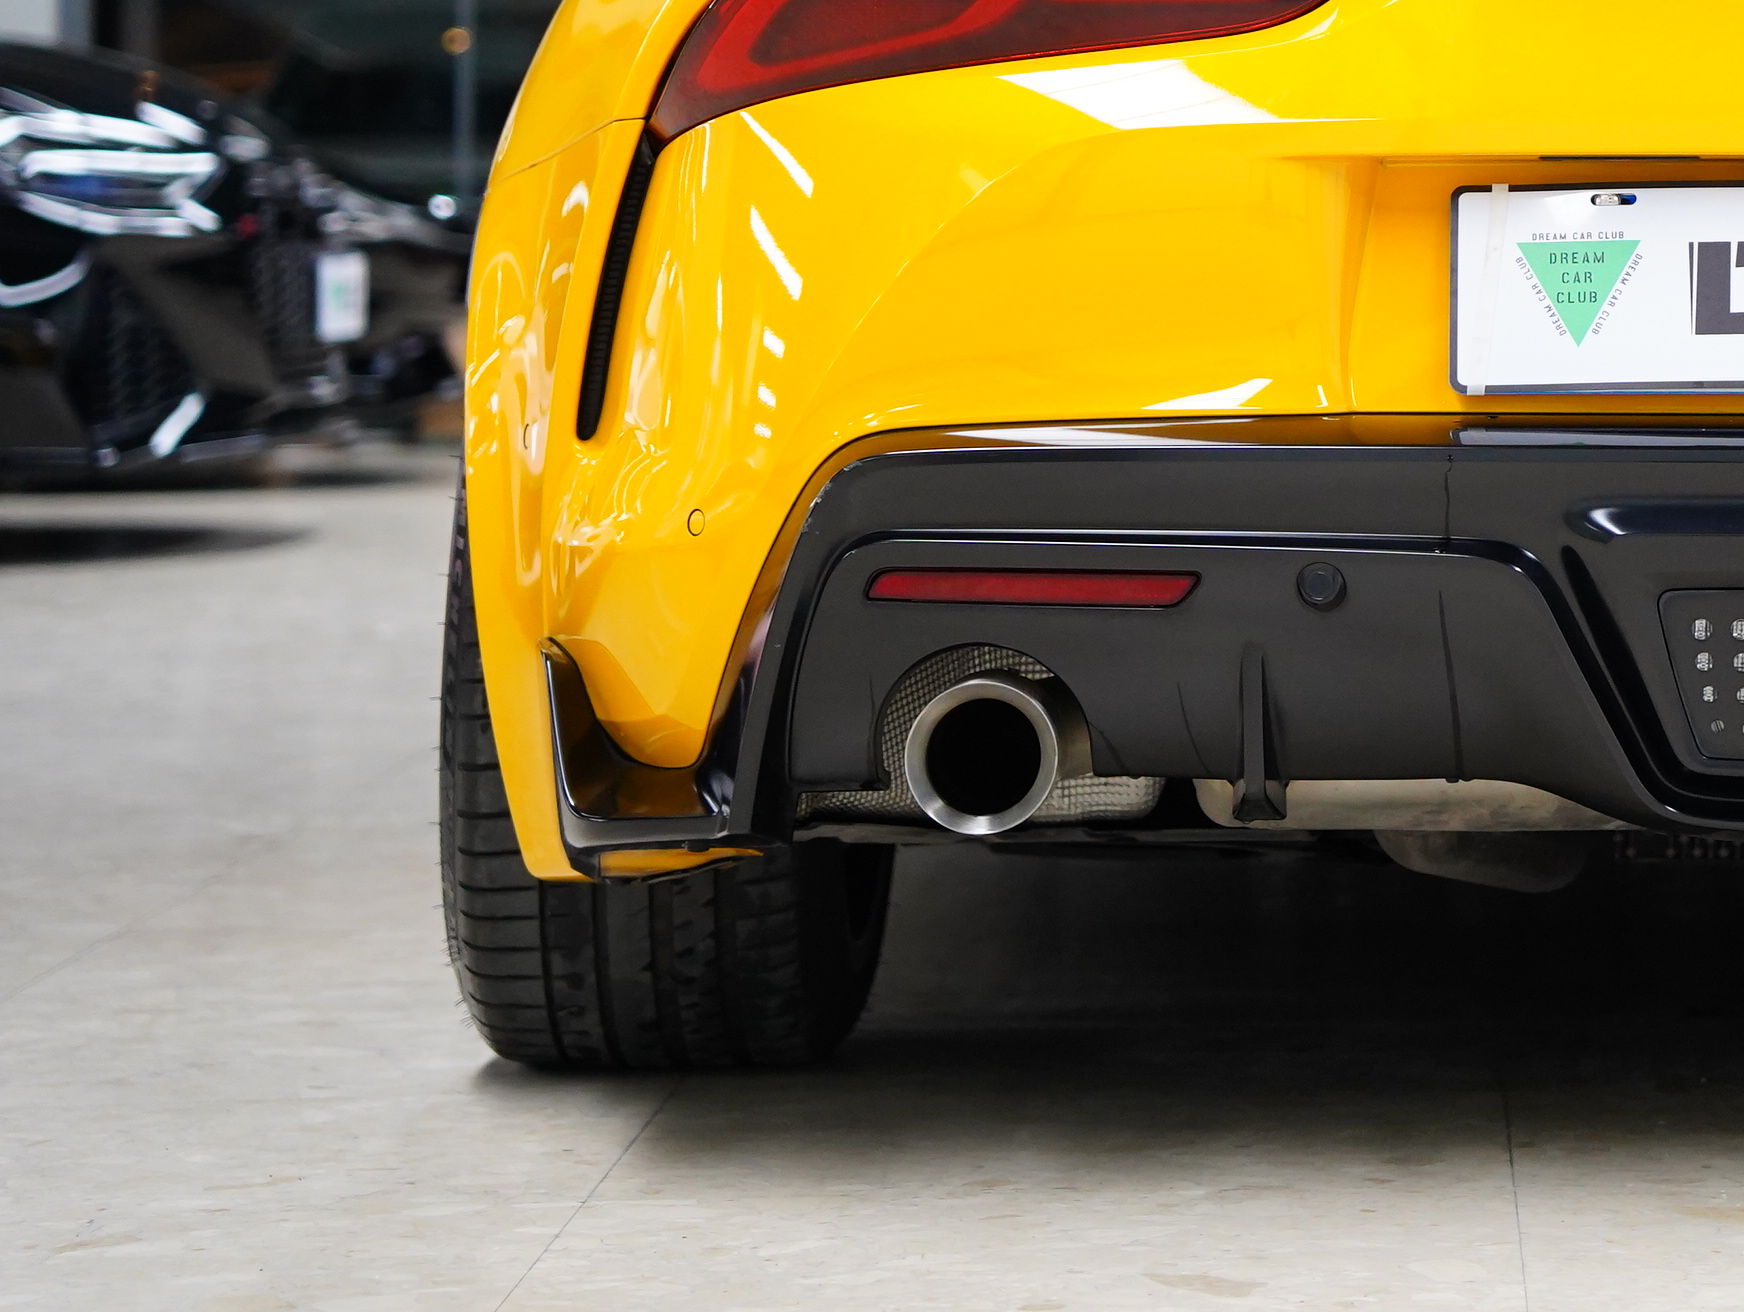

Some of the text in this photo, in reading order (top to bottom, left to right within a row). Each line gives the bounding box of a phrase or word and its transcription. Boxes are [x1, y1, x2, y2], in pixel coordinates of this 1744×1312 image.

[1532, 231, 1625, 241] DREAM CAR CLUB
[1549, 251, 1605, 264] DREAM
[1562, 271, 1593, 284] CAR
[1515, 256, 1567, 336] DREAM CAR CLUB
[1556, 291, 1598, 304] CLUB
[1591, 253, 1643, 335] DREAM CAR CLUB
